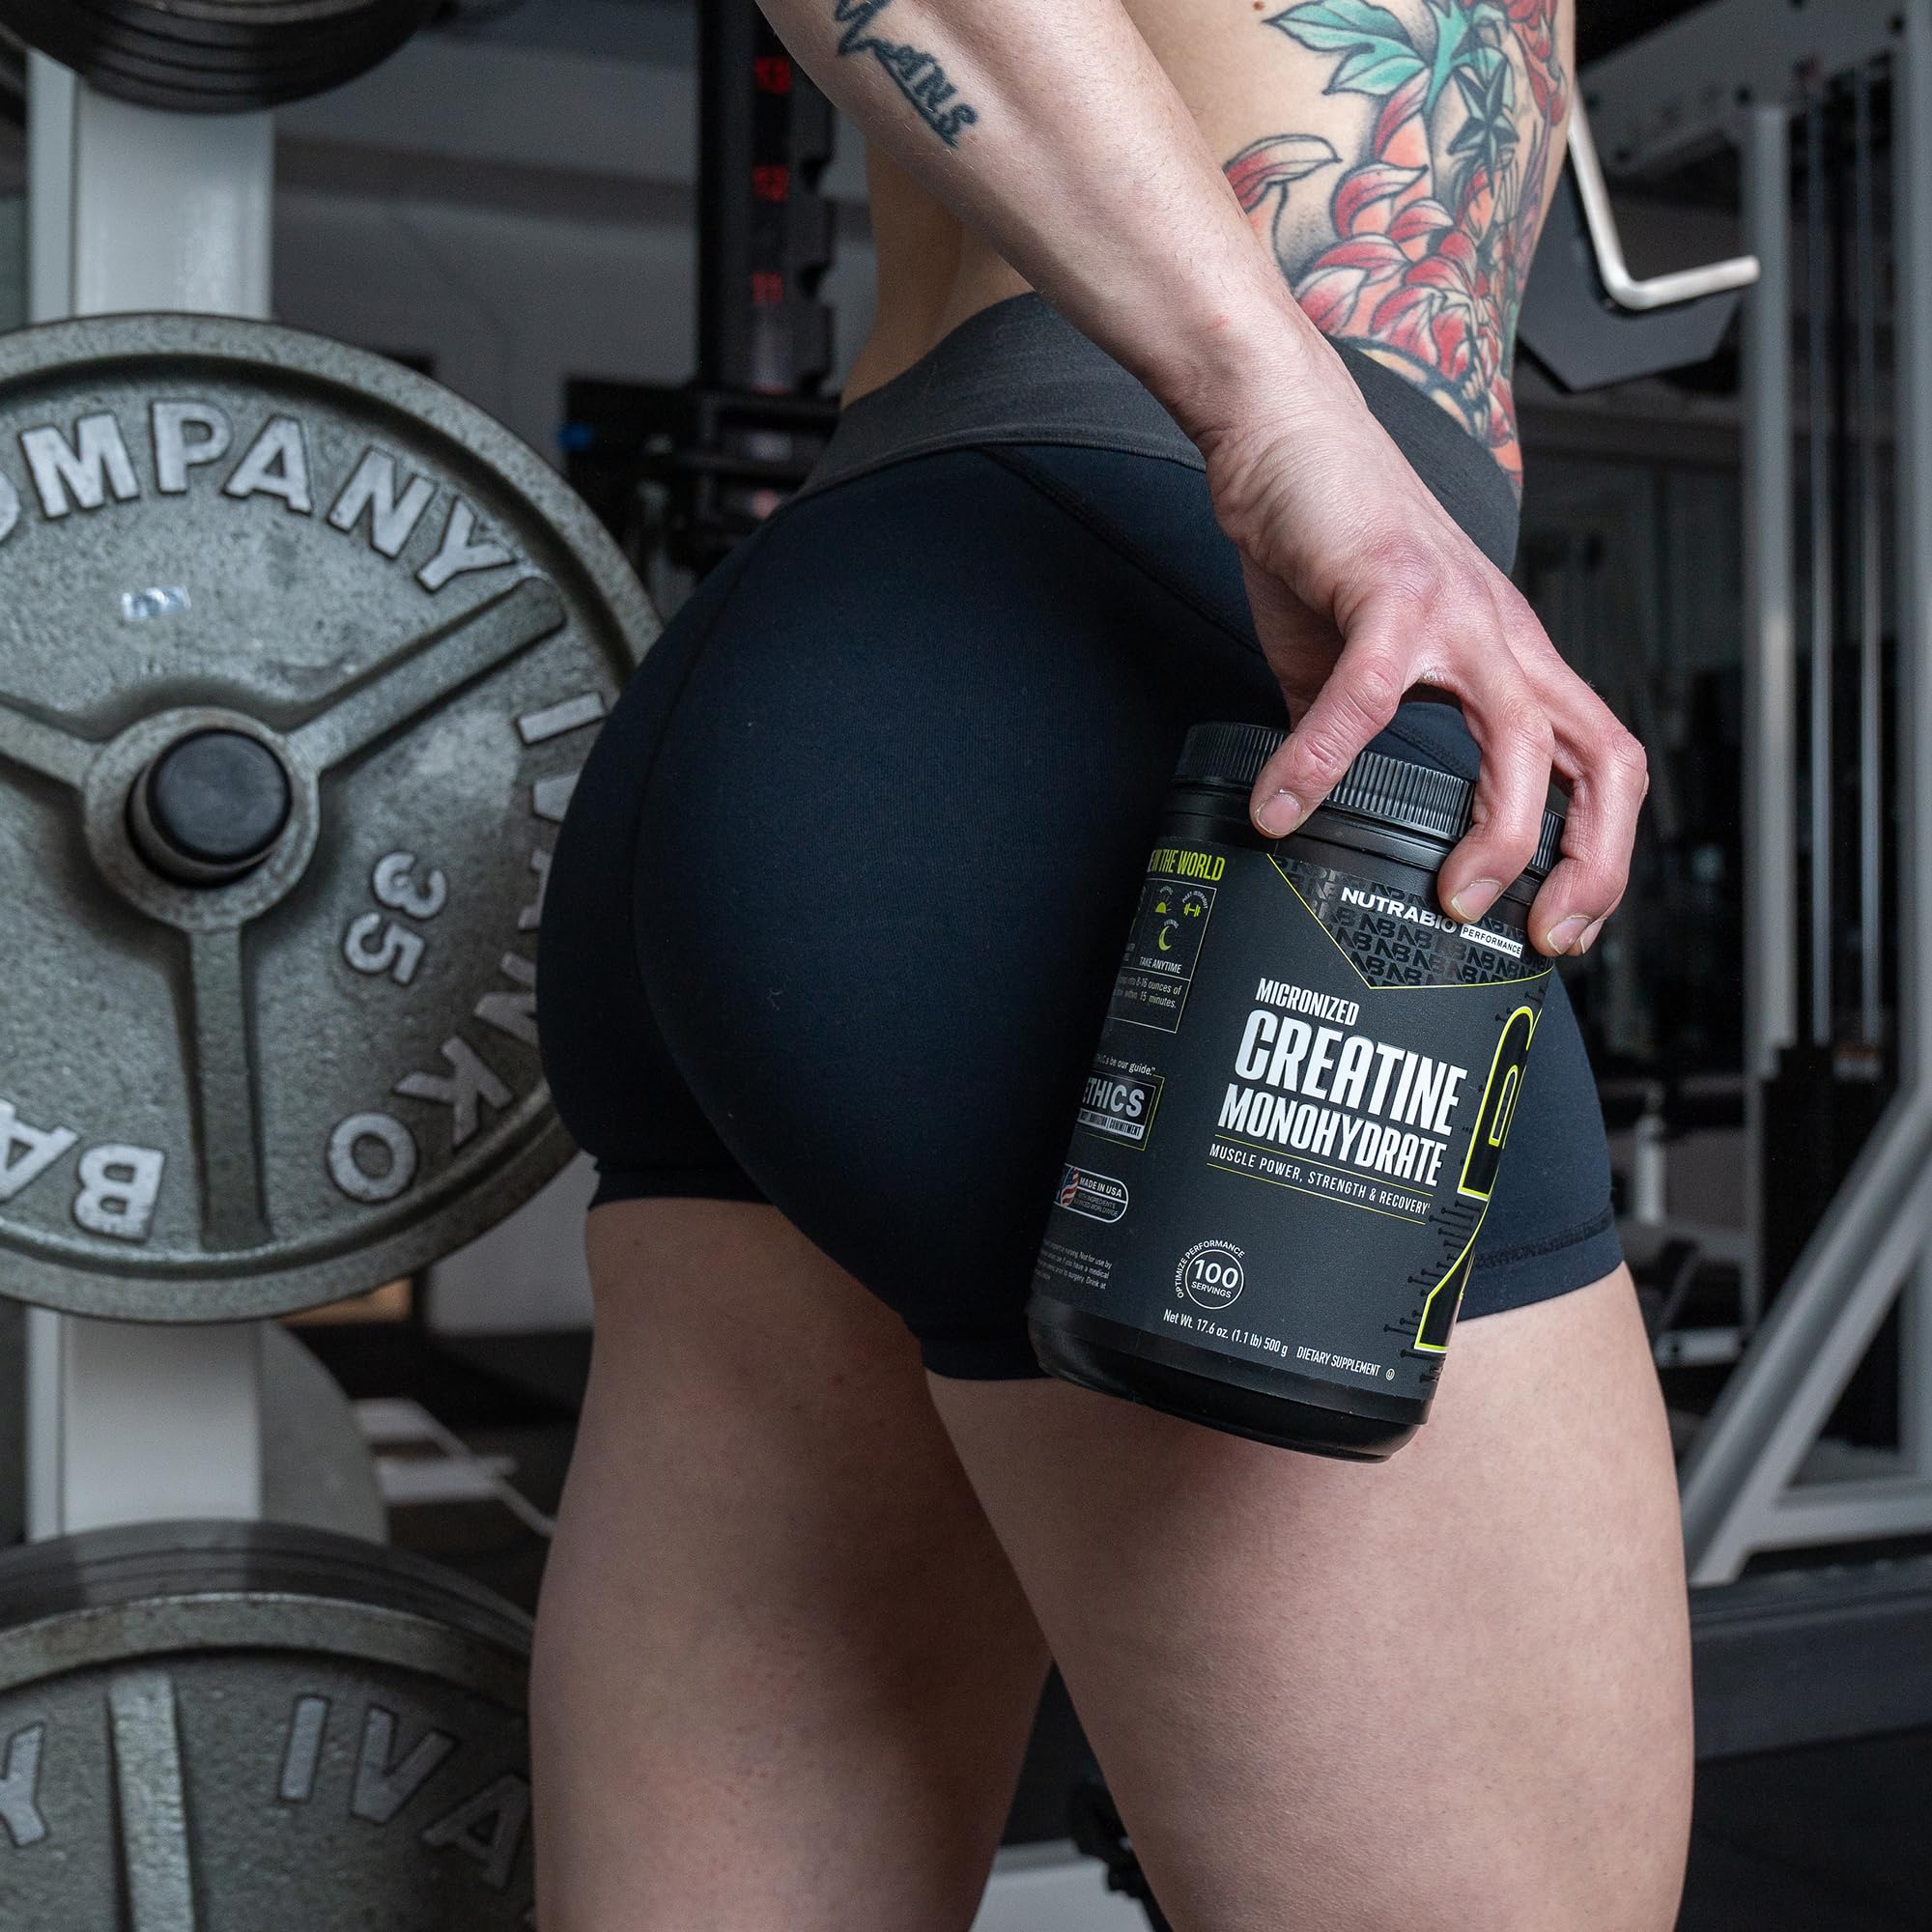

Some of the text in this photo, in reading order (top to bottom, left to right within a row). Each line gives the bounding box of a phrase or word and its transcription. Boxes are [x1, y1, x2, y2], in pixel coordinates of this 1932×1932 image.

[0, 401, 518, 593] MPANY
[1159, 849, 1179, 873] THE
[1177, 851, 1226, 881] WORLD
[344, 851, 448, 985] 35
[1340, 887, 1457, 933] NUTRABIO
[1462, 925, 1522, 955] PERFORMANCE
[1140, 956, 1182, 974] TAKE ANYTIME
[1148, 980, 1172, 994] ounces
[1173, 985, 1182, 996] of
[1149, 993, 1177, 1009] minutes.
[1255, 978, 1360, 1027] MICRONIZED
[1117, 1060, 1129, 1069] our
[1235, 1009, 1468, 1137] CREATINE
[1217, 1082, 1448, 1187] MONOHYDRATE
[1079, 1177, 1122, 1198] MADE IN USA
[1209, 1143, 1257, 1169] MUSCLE
[1259, 1157, 1303, 1183] POWER,
[1307, 1171, 1367, 1199] STRENGTH
[1369, 1188, 1378, 1202] &
[1175, 1239, 1245, 1298] OPTIMIZE PERFORMANCE
[1194, 1259, 1239, 1289] 100
[1191, 1281, 1233, 1299] SERVINGS
[1163, 1308, 1289, 1357] Net Wt. 17.6 oz. (1.1 lb) 500 g
[1296, 1346, 1381, 1377] DIETARY SUPPLEMENT
